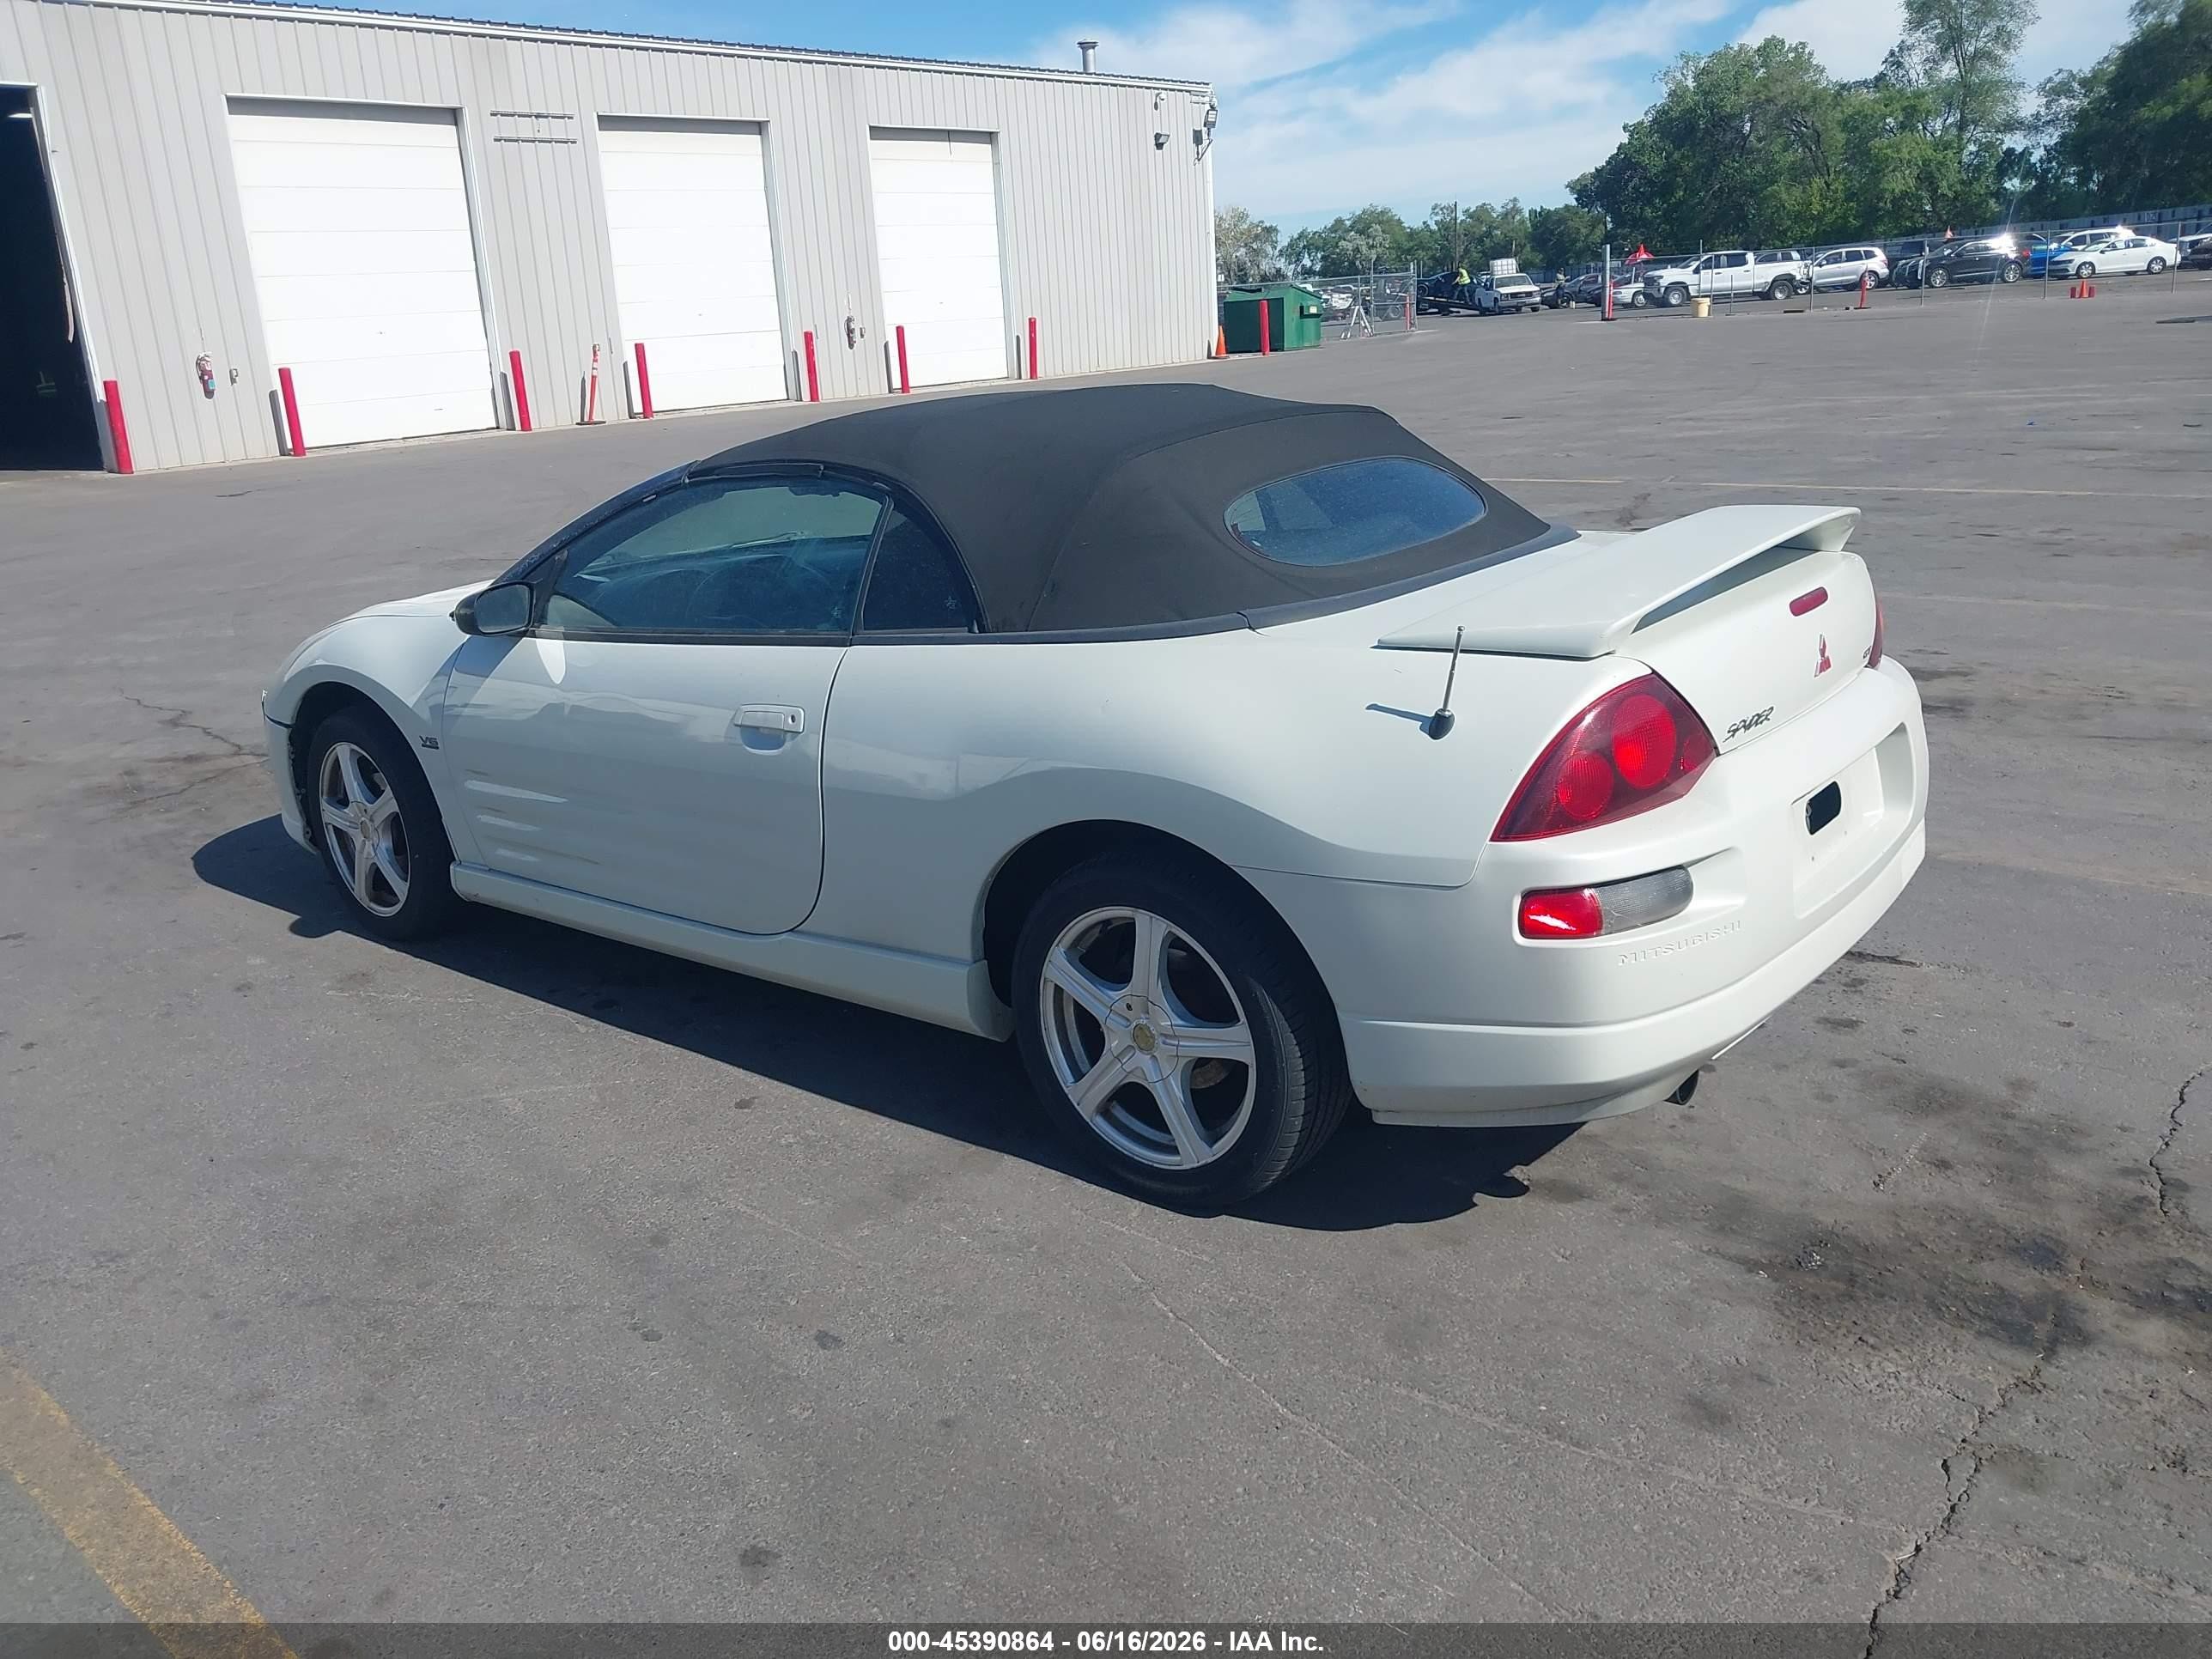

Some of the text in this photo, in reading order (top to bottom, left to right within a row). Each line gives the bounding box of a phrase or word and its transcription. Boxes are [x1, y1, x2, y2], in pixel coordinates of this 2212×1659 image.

[419, 735, 439, 750] V6
[1723, 706, 1774, 743] SPYDER
[1618, 921, 1741, 965] MITSUBISHI
